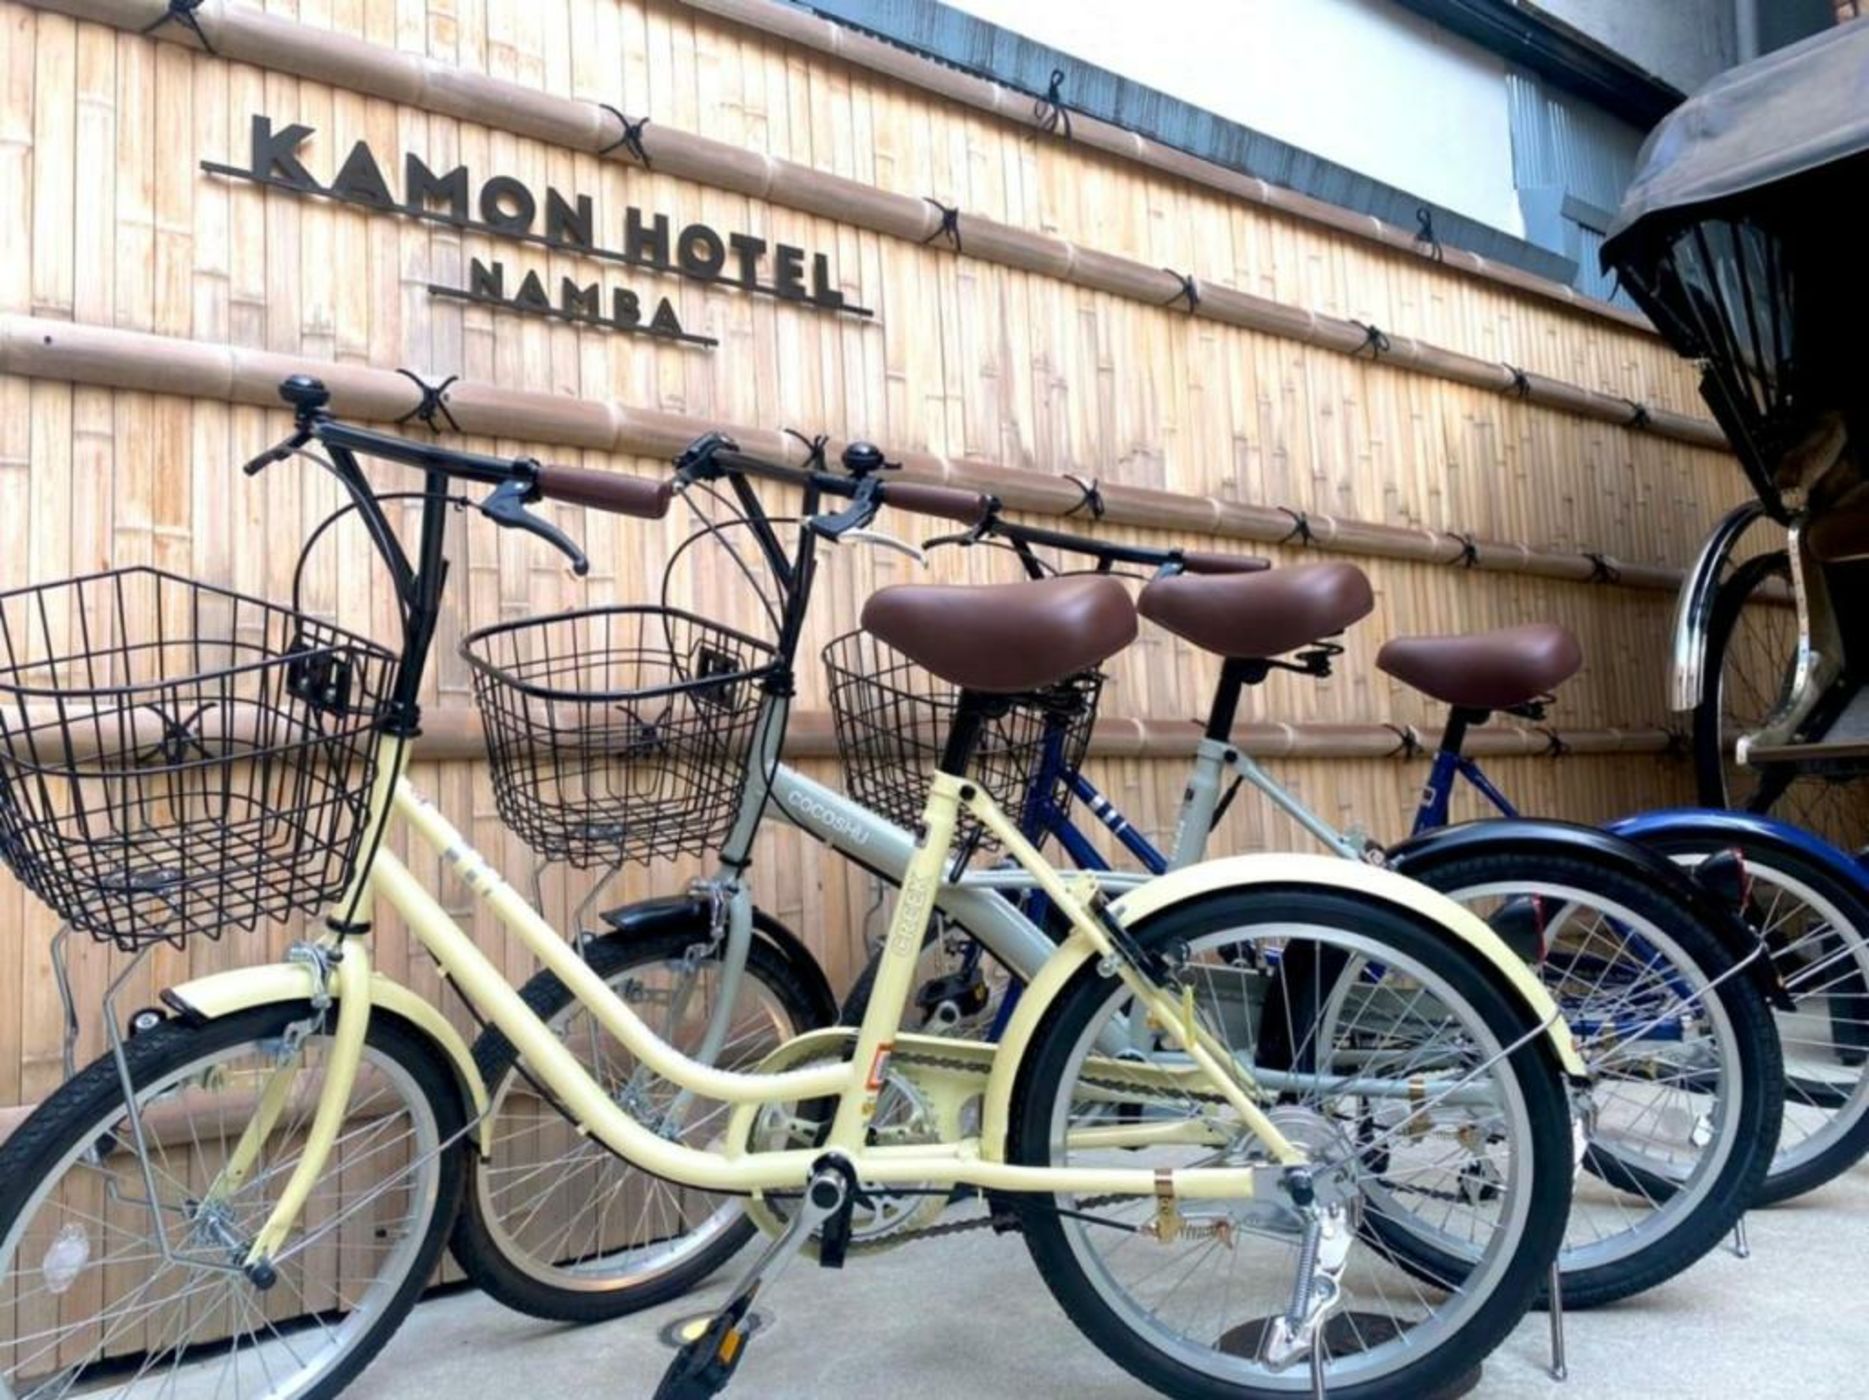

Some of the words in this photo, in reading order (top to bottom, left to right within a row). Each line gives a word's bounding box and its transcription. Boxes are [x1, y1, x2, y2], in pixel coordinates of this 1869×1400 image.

[252, 114, 592, 249] KAMON
[625, 206, 843, 309] HOTEL
[471, 257, 683, 337] NAMBA
[788, 790, 870, 845] COCOSHU
